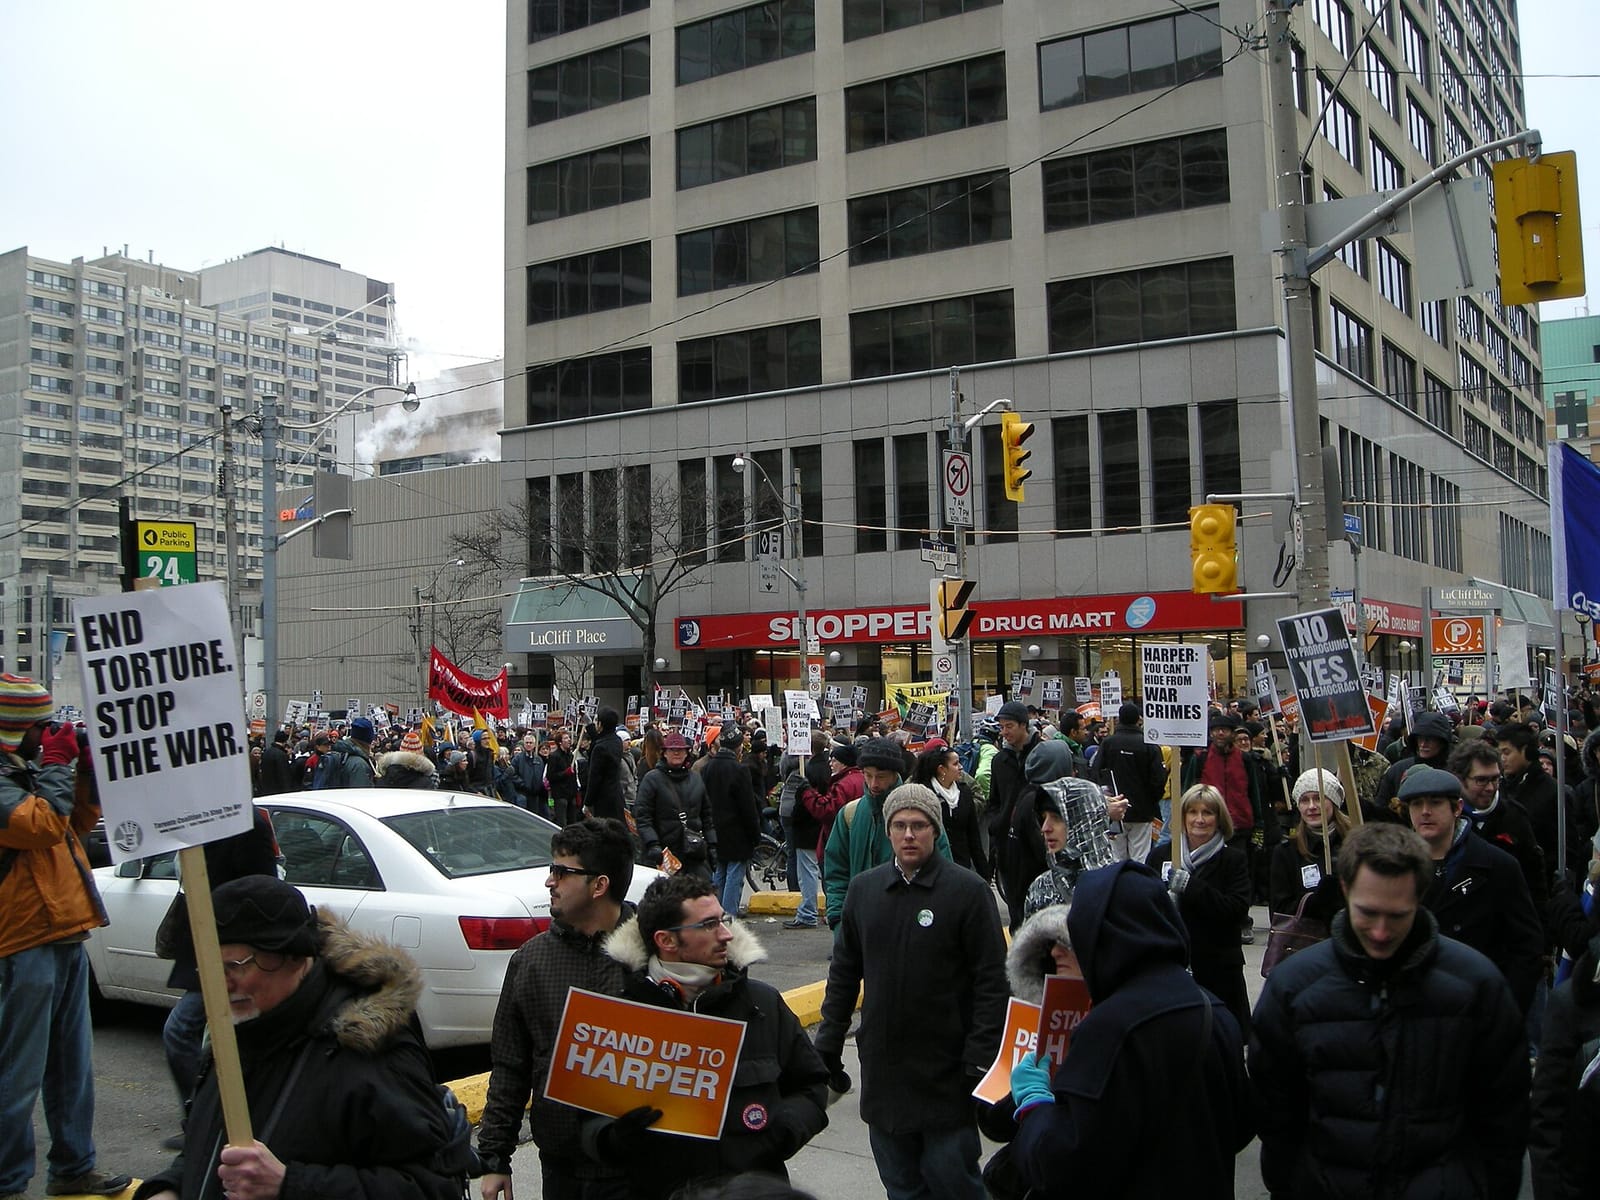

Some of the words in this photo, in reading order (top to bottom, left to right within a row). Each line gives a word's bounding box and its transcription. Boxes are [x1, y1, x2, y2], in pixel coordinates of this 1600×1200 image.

[162, 530, 187, 538] Public
[160, 538, 190, 548] Parking
[147, 556, 180, 585] 24
[1441, 589, 1472, 600] LuCliff
[1474, 589, 1494, 600] Place
[980, 614, 1042, 632] DRUG
[1050, 612, 1115, 629] MART
[1392, 616, 1406, 630] DRUG
[1407, 618, 1420, 632] MART
[82, 609, 144, 652] END
[530, 630, 572, 646] LuCliff
[576, 629, 606, 644] Place
[1294, 615, 1328, 646] NO
[1144, 648, 1198, 662] HARPER:
[1287, 648, 1298, 659] TO
[1298, 638, 1350, 658] PROROGUING
[88, 639, 233, 694] TORTURE.
[1144, 663, 1161, 674] YOU
[1163, 664, 1190, 674] CAN'T
[1298, 655, 1348, 688] YES
[1144, 675, 1164, 685] HIDE
[1166, 676, 1192, 686] FROM
[1144, 686, 1178, 702] WAR
[1298, 688, 1310, 700] TO
[1310, 679, 1360, 698] DEMOCRACY
[794, 702, 806, 710] Fair
[1412, 700, 1423, 709] ES
[1548, 690, 1557, 706] YE
[96, 690, 176, 739] STOP
[534, 712, 545, 720] YES
[672, 708, 685, 716] YES
[788, 711, 810, 720] Voting
[910, 713, 928, 723] YES
[1145, 703, 1202, 720] CRIMES
[800, 720, 808, 728] the
[793, 730, 808, 738] Cure
[101, 737, 161, 782] THE
[164, 722, 244, 768] WAR.
[1050, 1010, 1088, 1030] STA
[573, 1022, 654, 1057] STAND
[660, 1040, 692, 1062] UP
[698, 1046, 726, 1068] TO
[1015, 1028, 1038, 1050] DE
[565, 1043, 720, 1100] HARPER
